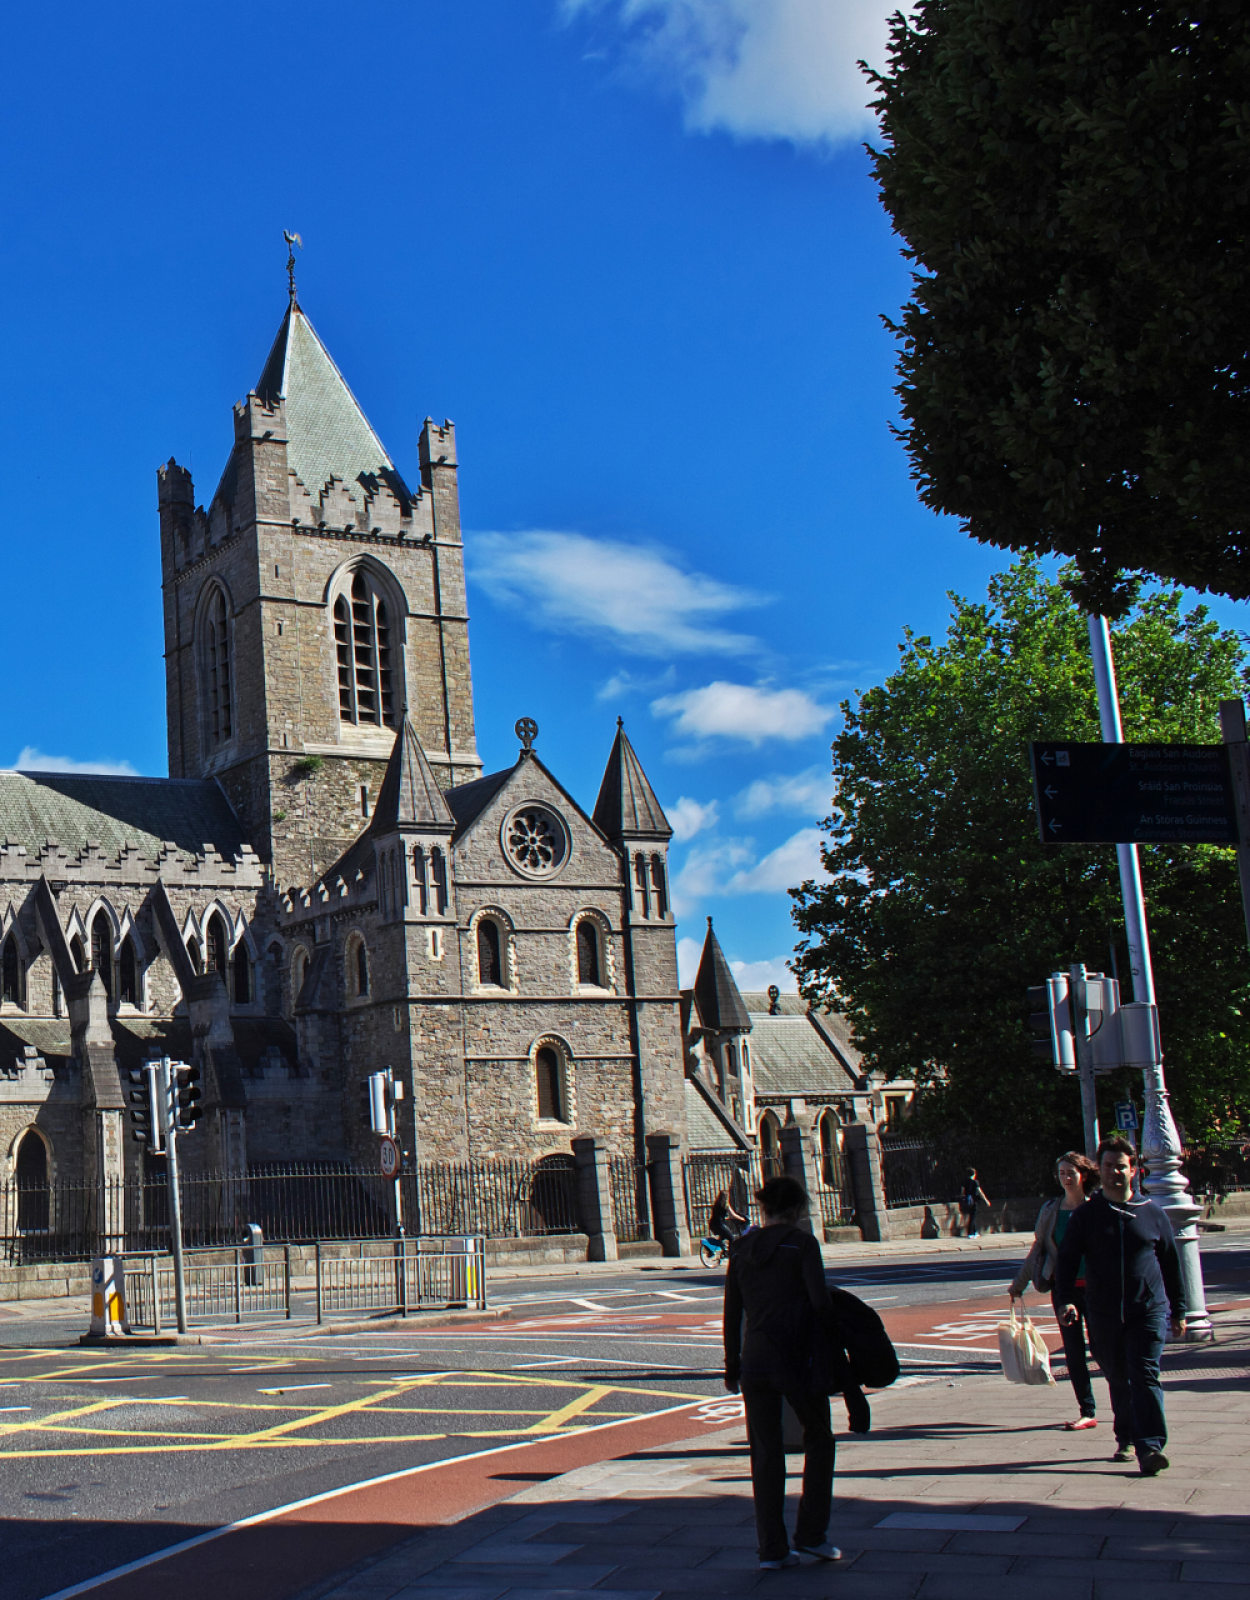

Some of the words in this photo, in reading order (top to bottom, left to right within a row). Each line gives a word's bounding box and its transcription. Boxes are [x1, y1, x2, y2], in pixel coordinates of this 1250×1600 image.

[1129, 748, 1161, 760] Eaglais
[1163, 749, 1180, 759] San
[1182, 749, 1219, 759] Audoen
[1188, 762, 1221, 772] Church
[1164, 781, 1180, 791] San
[1183, 781, 1223, 792] Proinsias
[1164, 795, 1196, 805] Francis
[1197, 795, 1225, 806] Street
[1140, 814, 1154, 825] An
[1154, 814, 1184, 825] Stóras
[1185, 814, 1228, 825] Guinness
[1134, 828, 1176, 838] Guinness
[1177, 828, 1229, 838] Storehouse
[1120, 1111, 1134, 1128] P
[383, 1147, 393, 1165] 30
